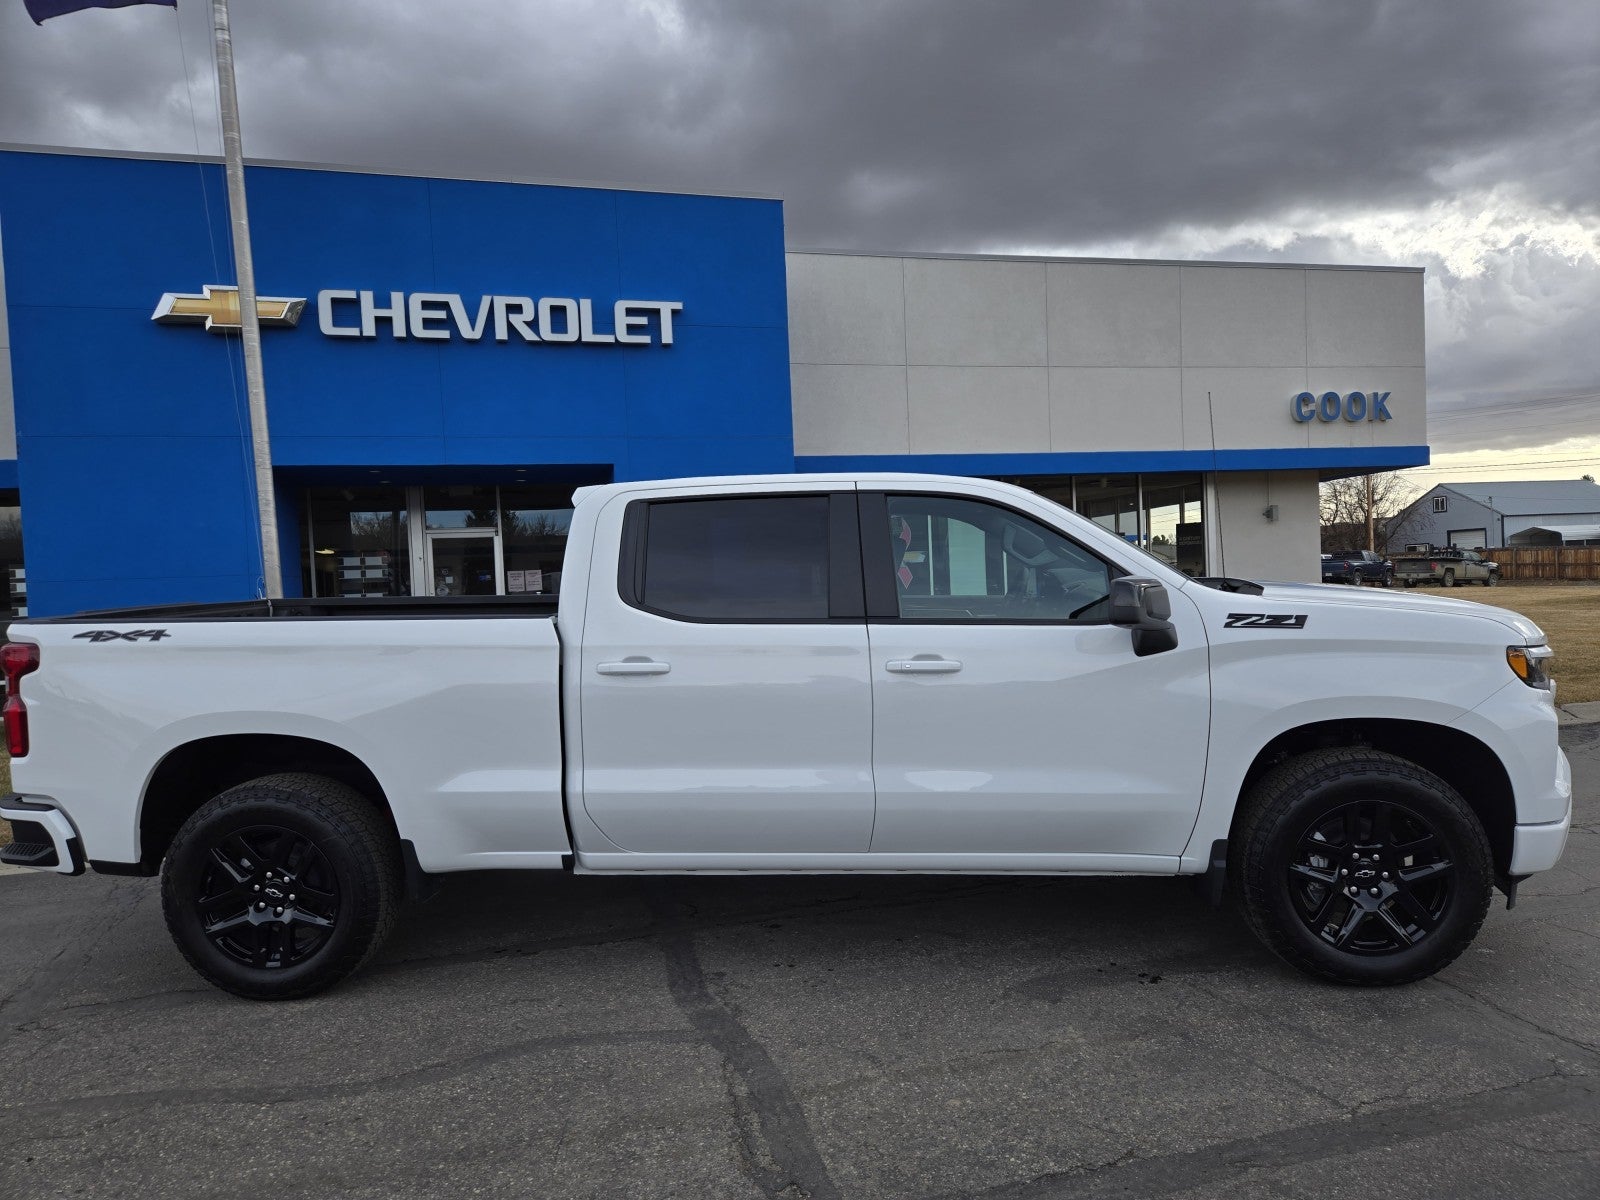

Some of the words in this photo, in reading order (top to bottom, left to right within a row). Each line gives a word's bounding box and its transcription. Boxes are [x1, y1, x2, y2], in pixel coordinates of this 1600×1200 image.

[318, 289, 683, 344] CHEVROLET
[1290, 391, 1393, 423] COOK
[1223, 613, 1309, 629] Z71
